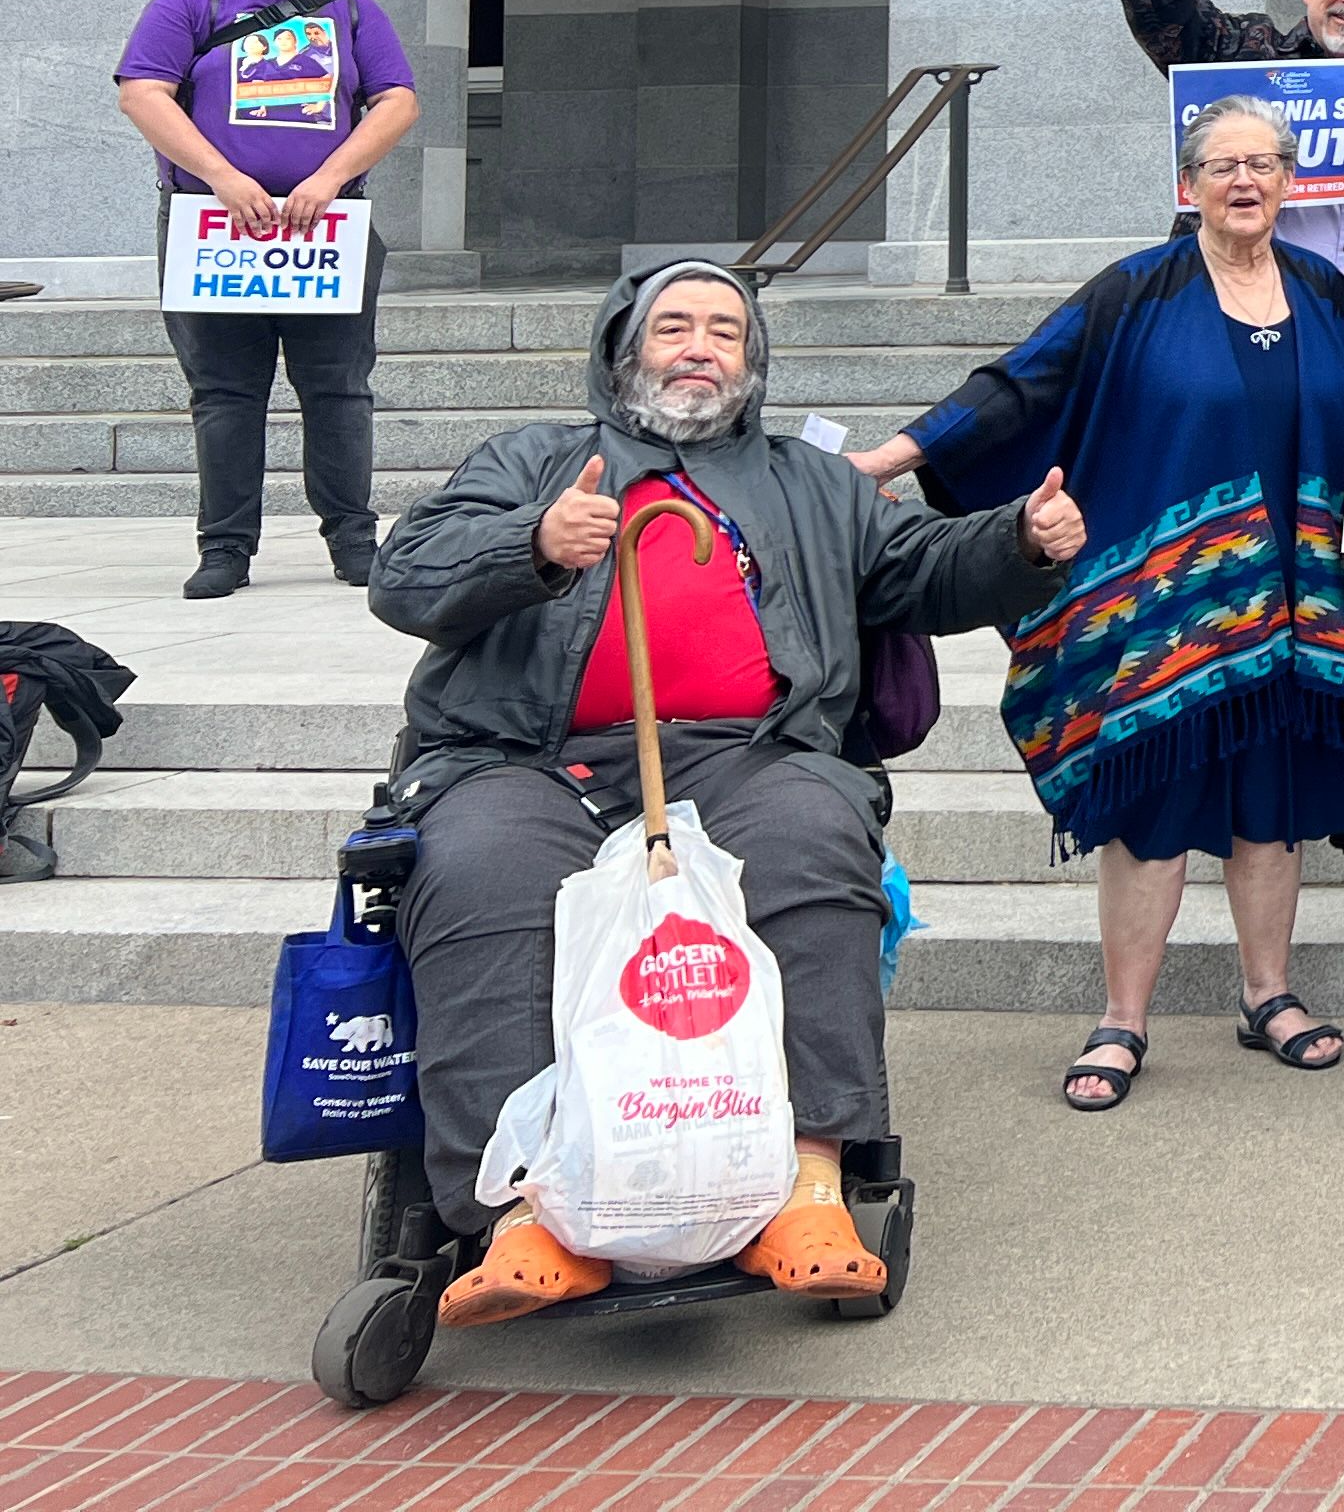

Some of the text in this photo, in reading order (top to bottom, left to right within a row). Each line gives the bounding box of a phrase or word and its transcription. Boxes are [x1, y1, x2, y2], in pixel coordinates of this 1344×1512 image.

[1307, 182, 1344, 193] RETIRED
[196, 247, 340, 270] FOR OUR
[192, 273, 340, 298] HEALTH
[302, 1057, 338, 1071] SAVE
[340, 1059, 372, 1071] OUR
[715, 1075, 733, 1086] TO
[313, 1097, 365, 1107] Conserve
[707, 1088, 762, 1119] Bliss
[322, 1109, 347, 1118] Rain
